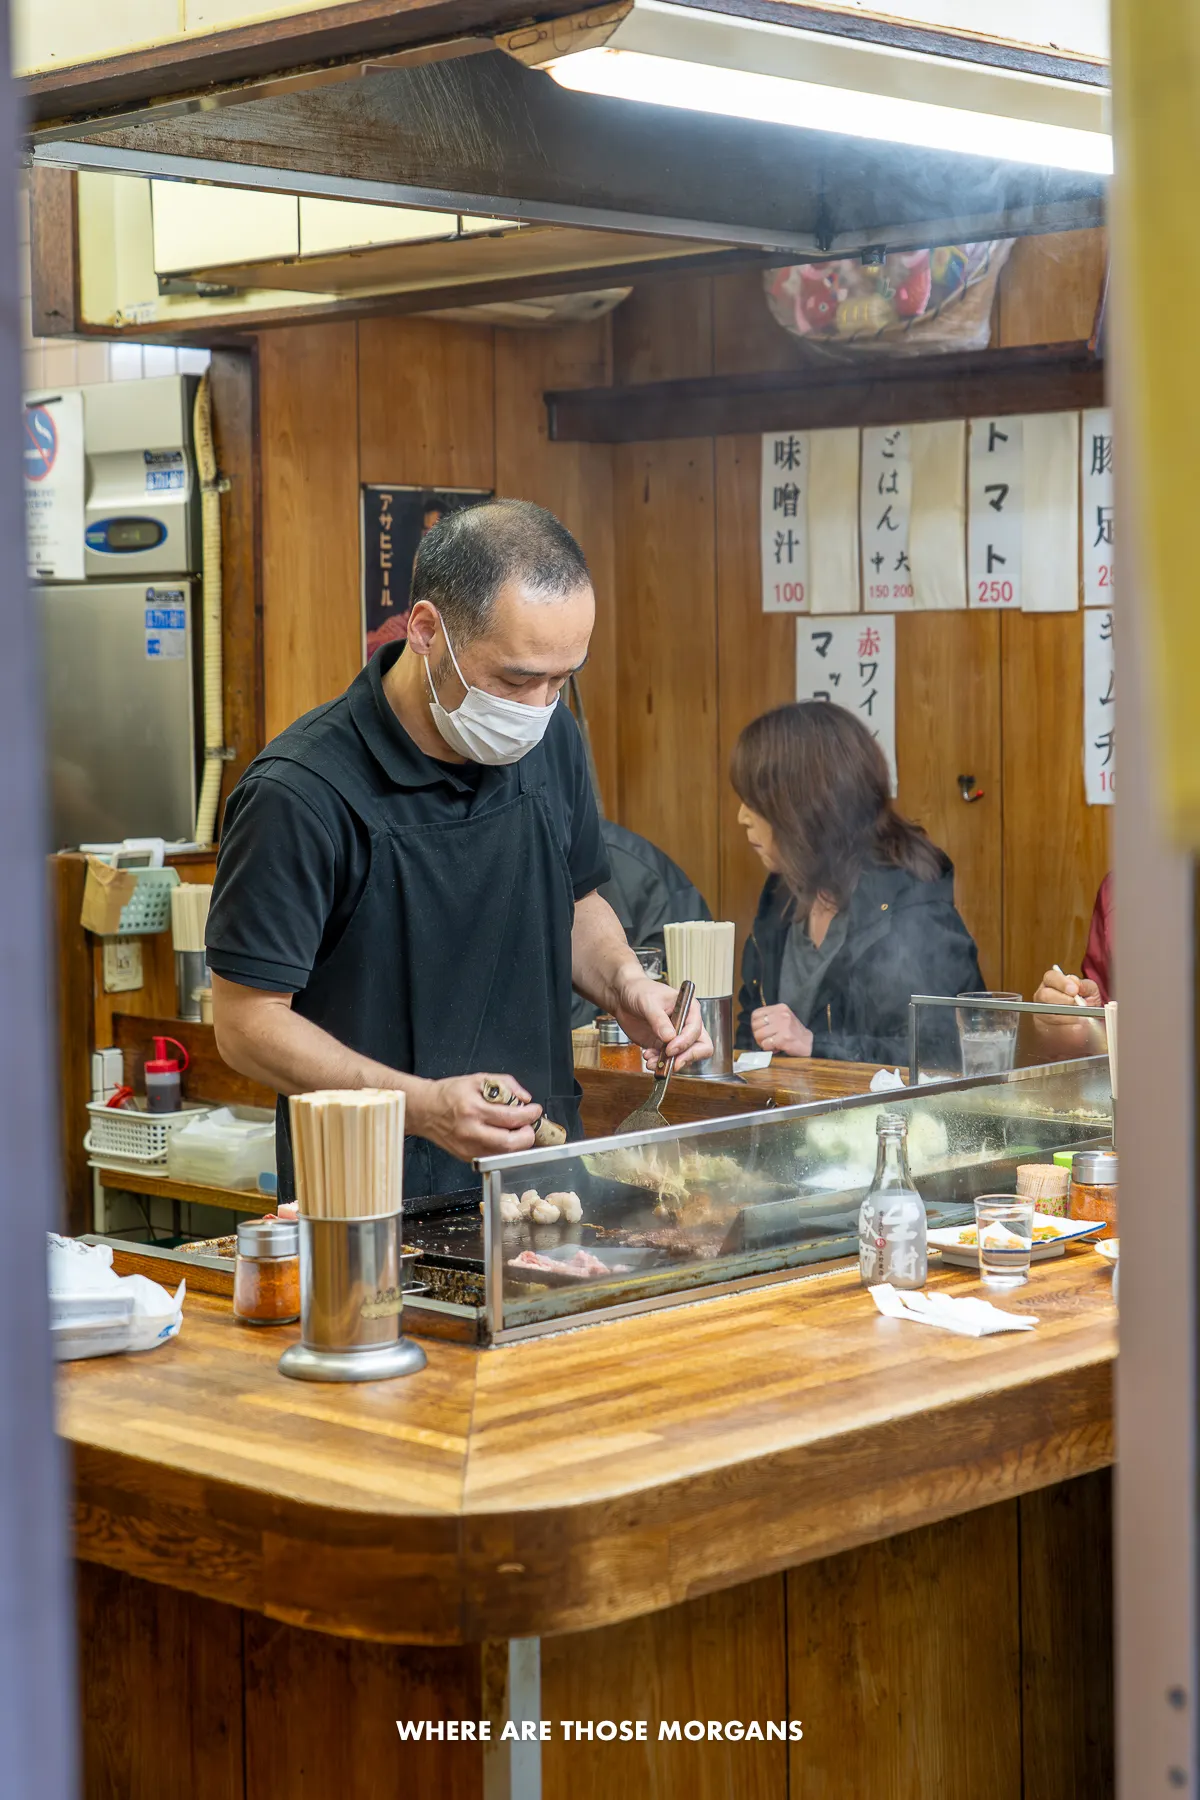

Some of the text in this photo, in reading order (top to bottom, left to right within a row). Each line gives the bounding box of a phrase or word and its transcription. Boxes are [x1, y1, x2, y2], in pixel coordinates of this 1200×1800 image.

[773, 435, 801, 564] 味噌汁
[877, 430, 901, 531] ごはん
[985, 421, 1009, 574] トマト
[379, 493, 394, 607] アサヒビール
[871, 550, 911, 574] 中 大
[1098, 564, 1113, 587] 2
[773, 582, 804, 604] 100
[869, 584, 914, 598] 150 200
[978, 580, 1013, 603] 250
[858, 626, 880, 738] 赤ワイ
